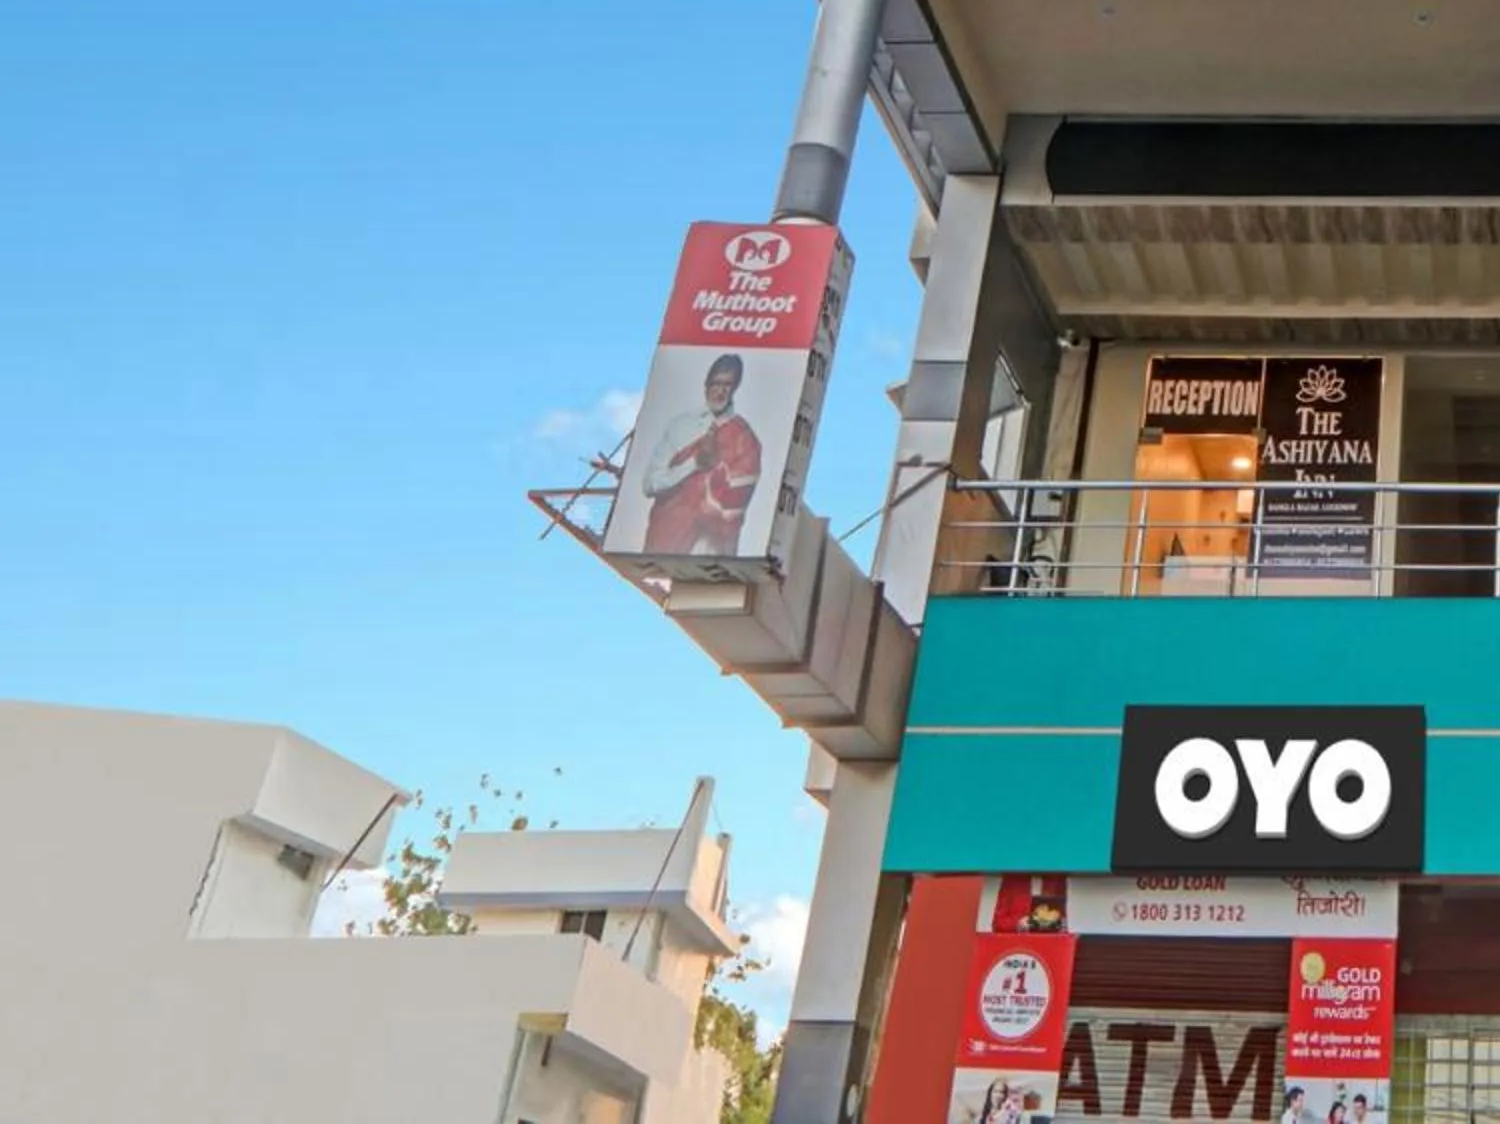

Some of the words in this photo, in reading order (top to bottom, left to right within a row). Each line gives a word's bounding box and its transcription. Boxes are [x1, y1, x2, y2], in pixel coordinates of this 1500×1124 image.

[729, 272, 773, 291] The
[693, 290, 798, 313] Muthoot
[702, 311, 778, 338] Group
[1148, 379, 1260, 416] RECEPTION
[1296, 407, 1343, 436] THE
[1261, 435, 1373, 465] ASHIYANA
[1155, 737, 1392, 841] OYO
[1131, 903, 1167, 921] 1800
[1173, 904, 1200, 922] 313
[1207, 905, 1246, 923] 1212
[1337, 967, 1382, 983] GOLD
[1056, 1022, 1283, 1121] ATM
